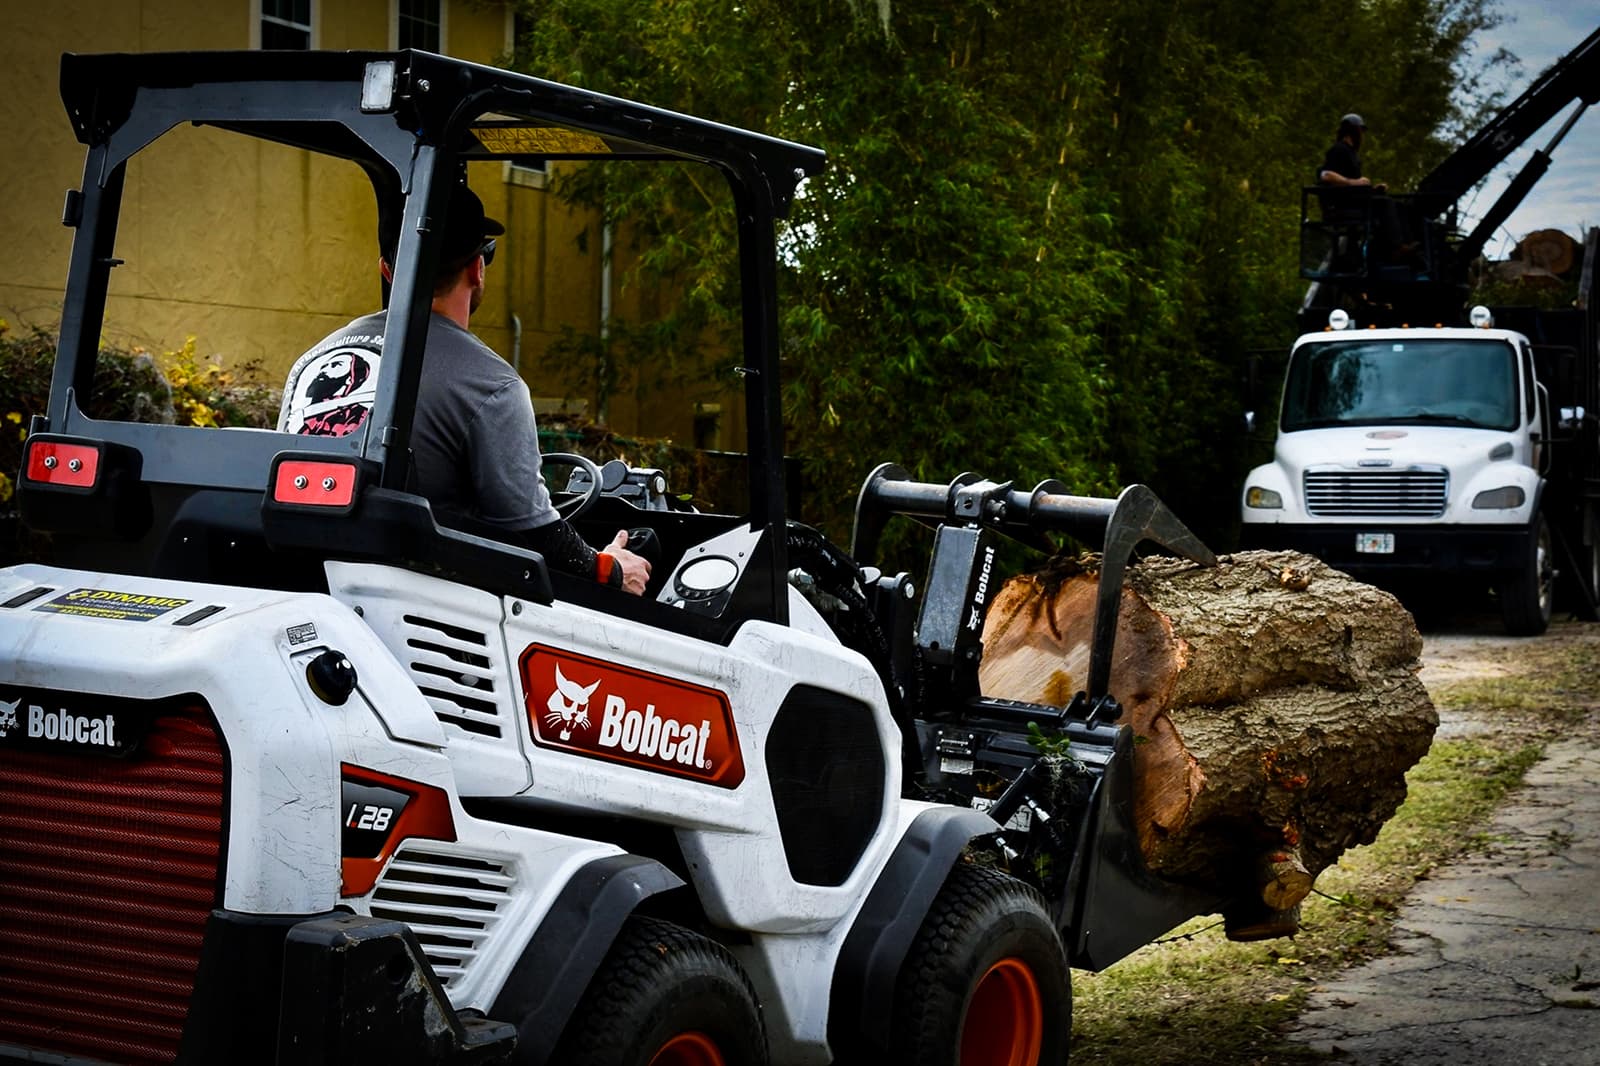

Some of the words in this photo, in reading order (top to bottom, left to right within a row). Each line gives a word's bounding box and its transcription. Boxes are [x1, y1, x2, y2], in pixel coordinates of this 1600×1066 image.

[89, 591, 187, 607] DYNAMIC
[975, 546, 995, 604] Bobcat
[28, 704, 116, 747] Bobcat
[599, 694, 711, 769] Bobcat
